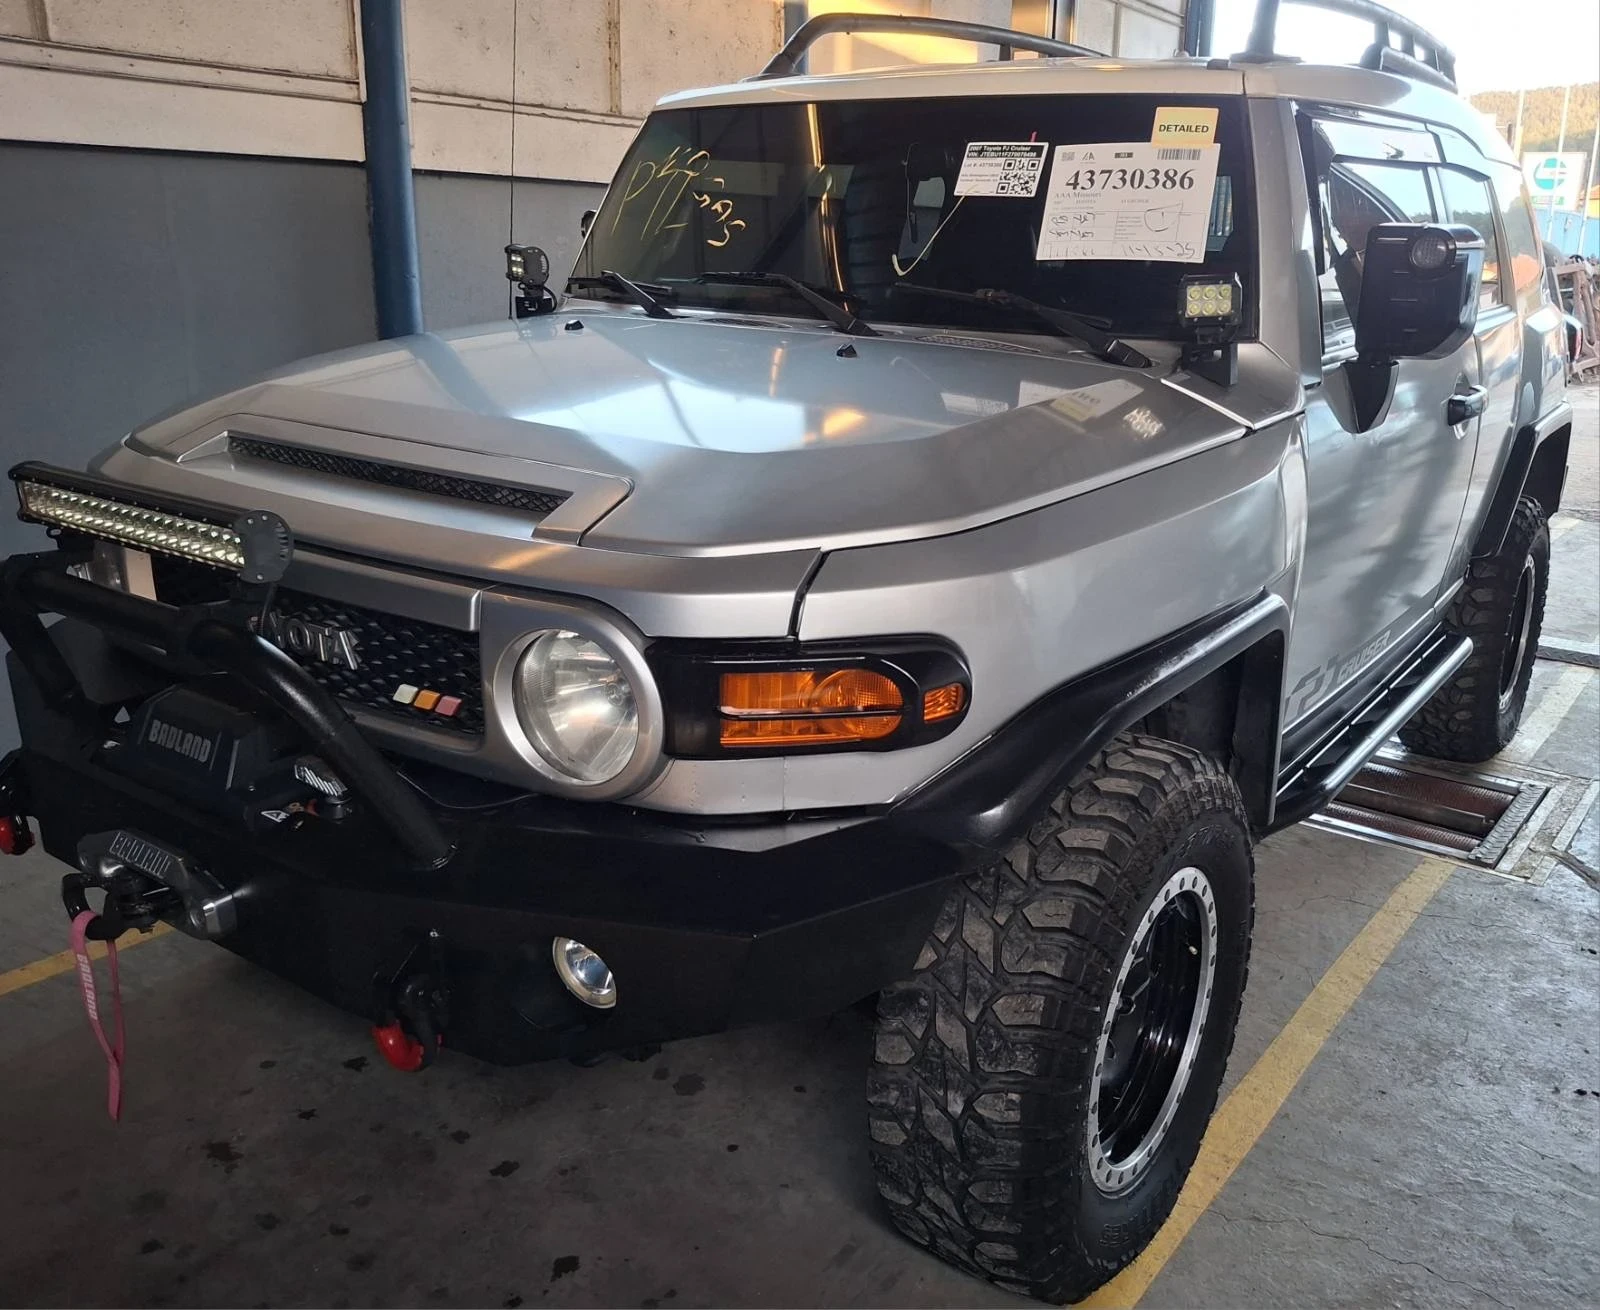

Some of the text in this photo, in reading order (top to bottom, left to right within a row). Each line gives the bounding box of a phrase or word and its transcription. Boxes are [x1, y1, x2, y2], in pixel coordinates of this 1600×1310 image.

[1158, 124, 1210, 133] DETAILED
[1065, 168, 1195, 191] 43730386
[269, 608, 363, 671] YOTA
[1337, 629, 1391, 685] CRUISER
[148, 719, 212, 763] BADLAND
[76, 953, 99, 1021] BADLAND
